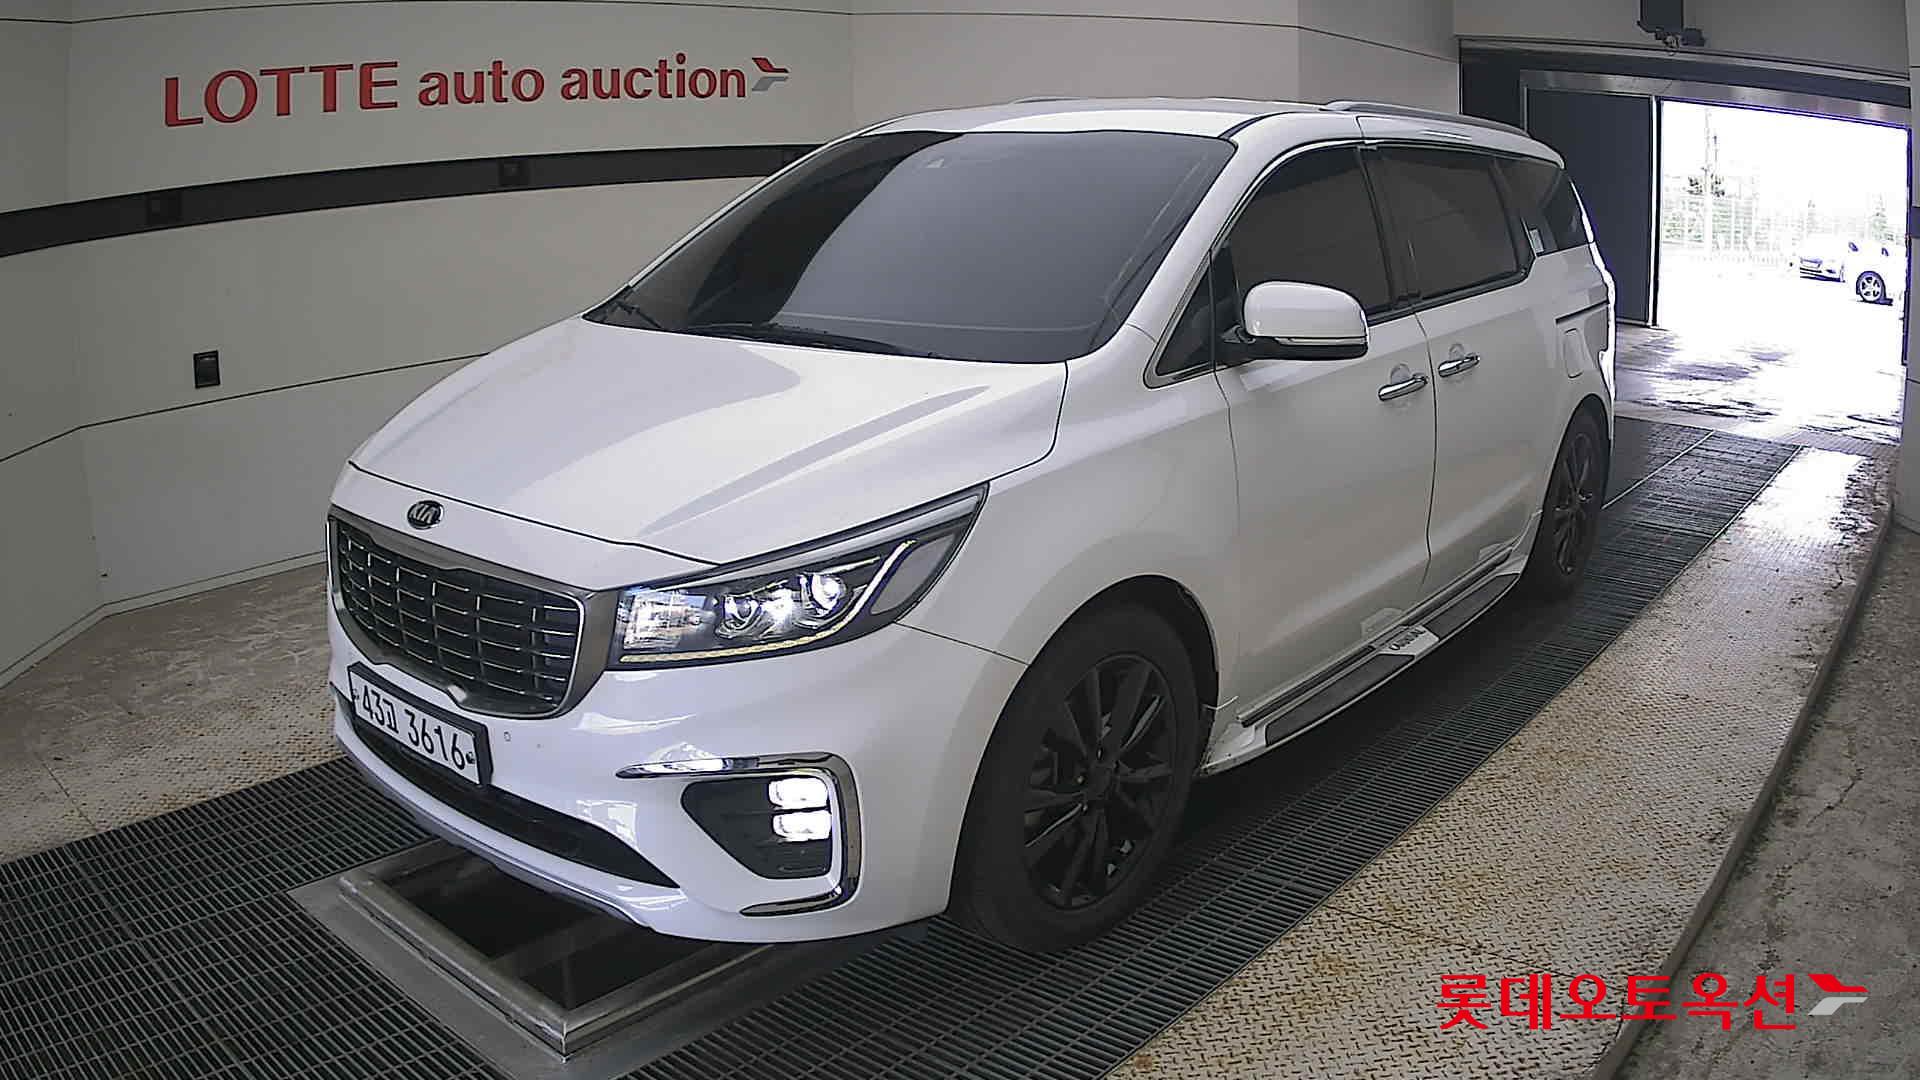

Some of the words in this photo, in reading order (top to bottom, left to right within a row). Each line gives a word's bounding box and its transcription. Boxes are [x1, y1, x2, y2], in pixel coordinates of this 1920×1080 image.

[164, 61, 399, 127] LOTTE
[418, 60, 545, 106] auto
[560, 53, 746, 101] auction
[408, 503, 440, 525] KIA
[404, 708, 466, 771] 3616
